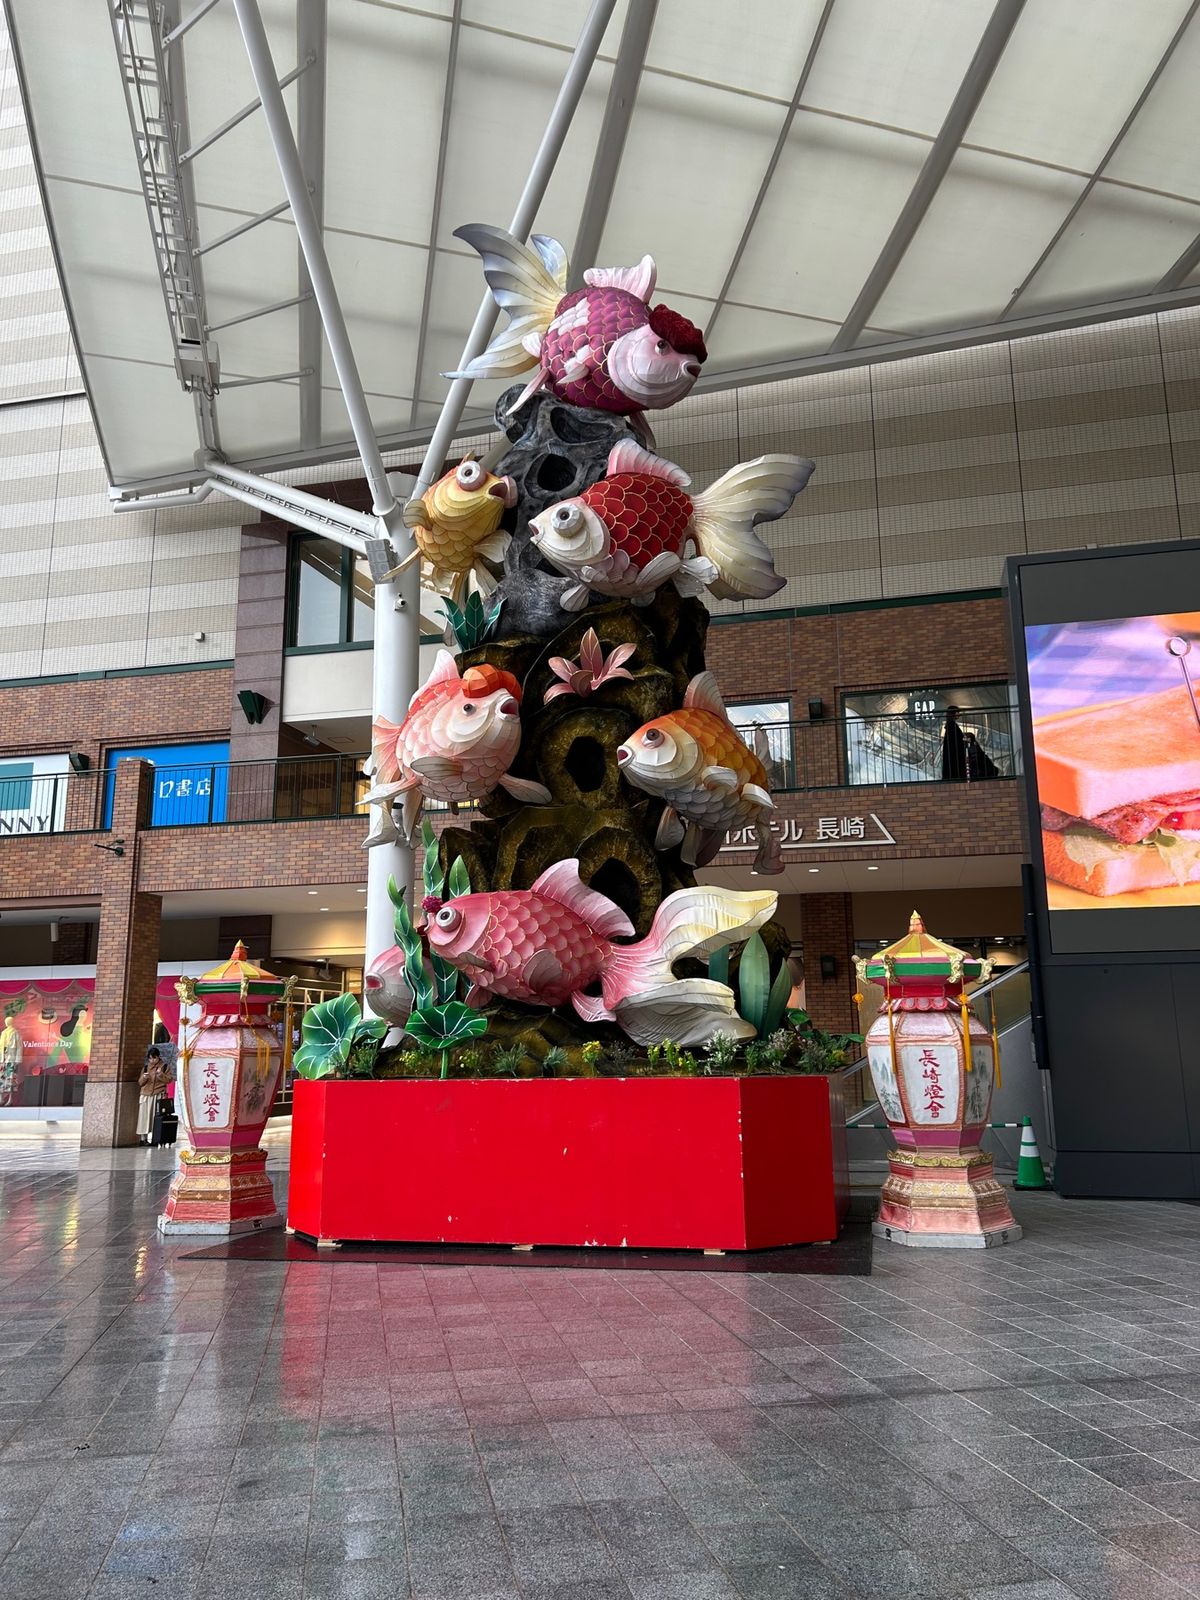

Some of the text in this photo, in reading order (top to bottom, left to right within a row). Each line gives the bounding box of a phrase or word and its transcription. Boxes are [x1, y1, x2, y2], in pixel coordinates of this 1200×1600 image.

[914, 700, 936, 713] GAP
[154, 777, 211, 799] ロ書店
[816, 816, 866, 840] 長崎
[60, 1040, 73, 1049] Day
